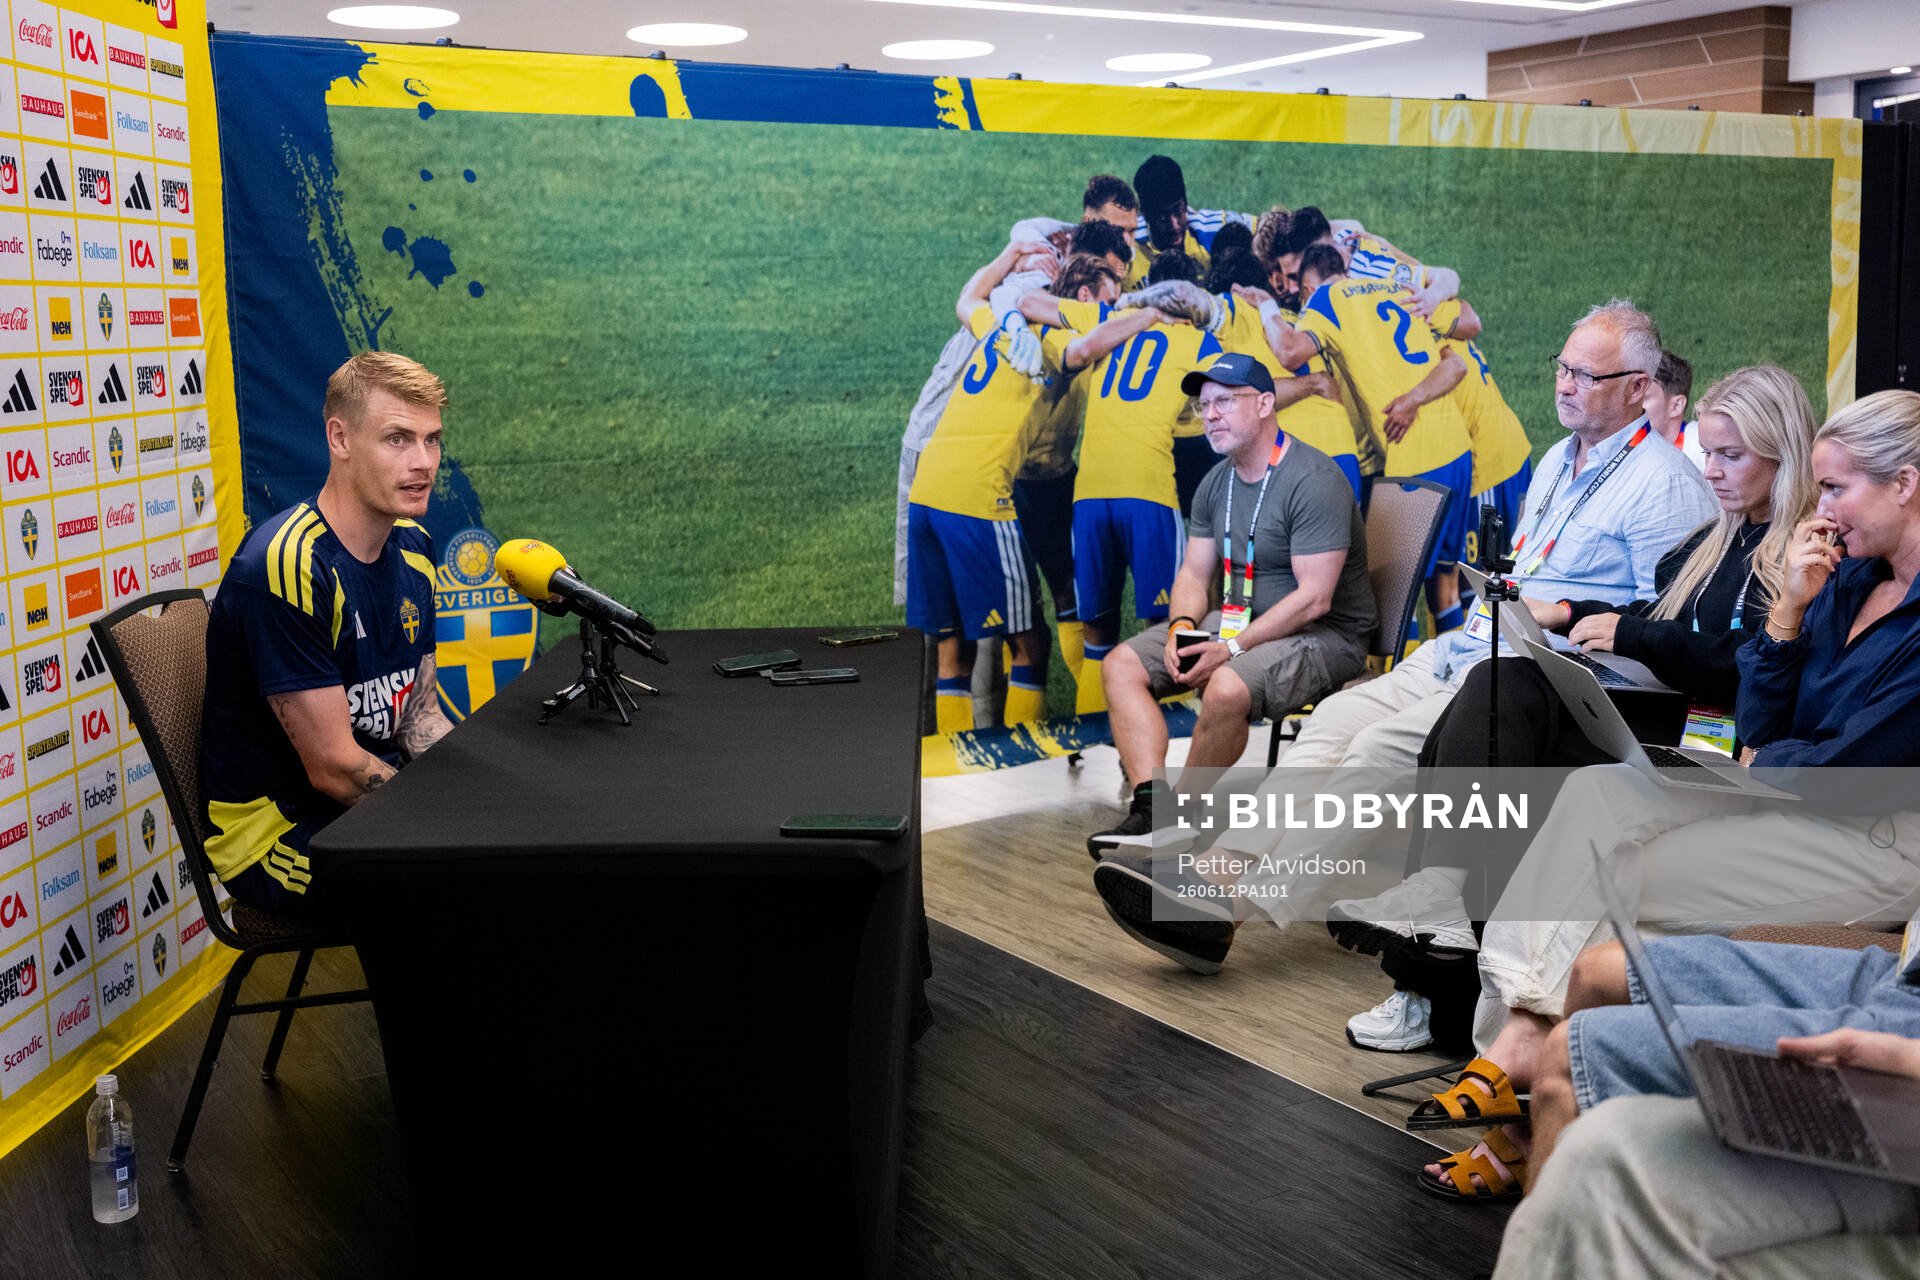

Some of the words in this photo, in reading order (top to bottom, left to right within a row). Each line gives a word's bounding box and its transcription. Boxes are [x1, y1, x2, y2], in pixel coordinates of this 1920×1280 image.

[69, 28, 98, 65] ICA
[109, 47, 145, 69] BAUHAUS
[21, 96, 64, 117] BAUHAUS
[117, 111, 148, 133] Folksam
[157, 123, 186, 142] Scandic
[80, 183, 96, 198] SPEL
[163, 194, 177, 208] SPEL
[37, 238, 72, 267] Fabege
[83, 241, 117, 260] Folksam
[129, 239, 155, 268] ICA
[129, 311, 164, 325] BAUHAUS
[1376, 300, 1429, 365] 2
[1100, 330, 1169, 401] 10
[50, 389, 68, 403] SPEL
[138, 381, 153, 395] SPEL
[180, 432, 206, 452] Fabege
[7, 449, 40, 483] ICA
[53, 447, 91, 468] Scandic
[1598, 460, 1618, 484] WORLD
[146, 499, 176, 517] Folksam
[58, 516, 98, 538] BAUHAUS
[151, 558, 182, 579] Scandic
[187, 547, 219, 568] BAUHAUS
[113, 565, 140, 597] ICA
[434, 589, 519, 609] SVERIGE
[26, 679, 44, 696] SPEL
[82, 708, 111, 744] ICA
[127, 760, 155, 784] Folksa
[84, 783, 117, 811] Fabege
[36, 802, 73, 831] Scandic
[43, 870, 80, 901] Folksam
[180, 870, 192, 889] SPE
[0, 891, 28, 928] CA
[98, 923, 115, 944] SPEL
[180, 916, 208, 944] BAUHA
[103, 974, 135, 1007] Fabege
[4, 1035, 43, 1072] Scandic
